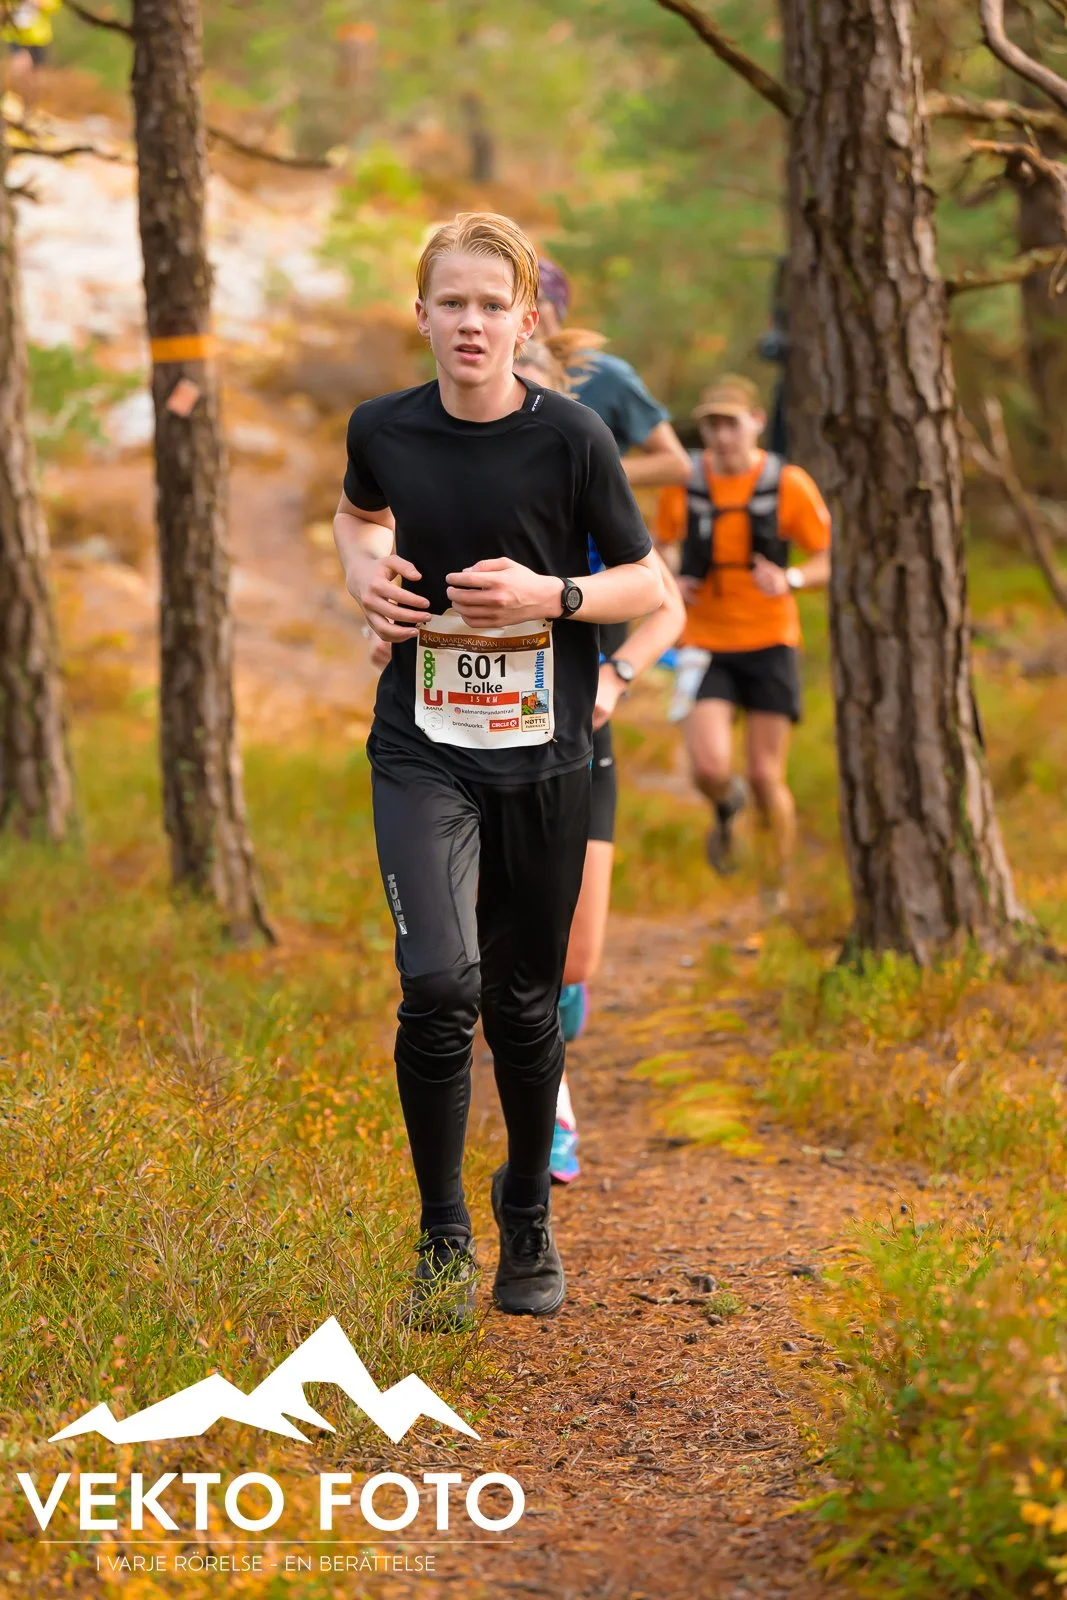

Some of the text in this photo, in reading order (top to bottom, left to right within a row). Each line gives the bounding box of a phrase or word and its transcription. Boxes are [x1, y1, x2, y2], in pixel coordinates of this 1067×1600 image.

[424, 650, 435, 688] coop
[457, 654, 506, 679] 601
[535, 651, 544, 688] Aktivitus
[465, 682, 503, 694] Folke
[486, 695, 498, 703] KM
